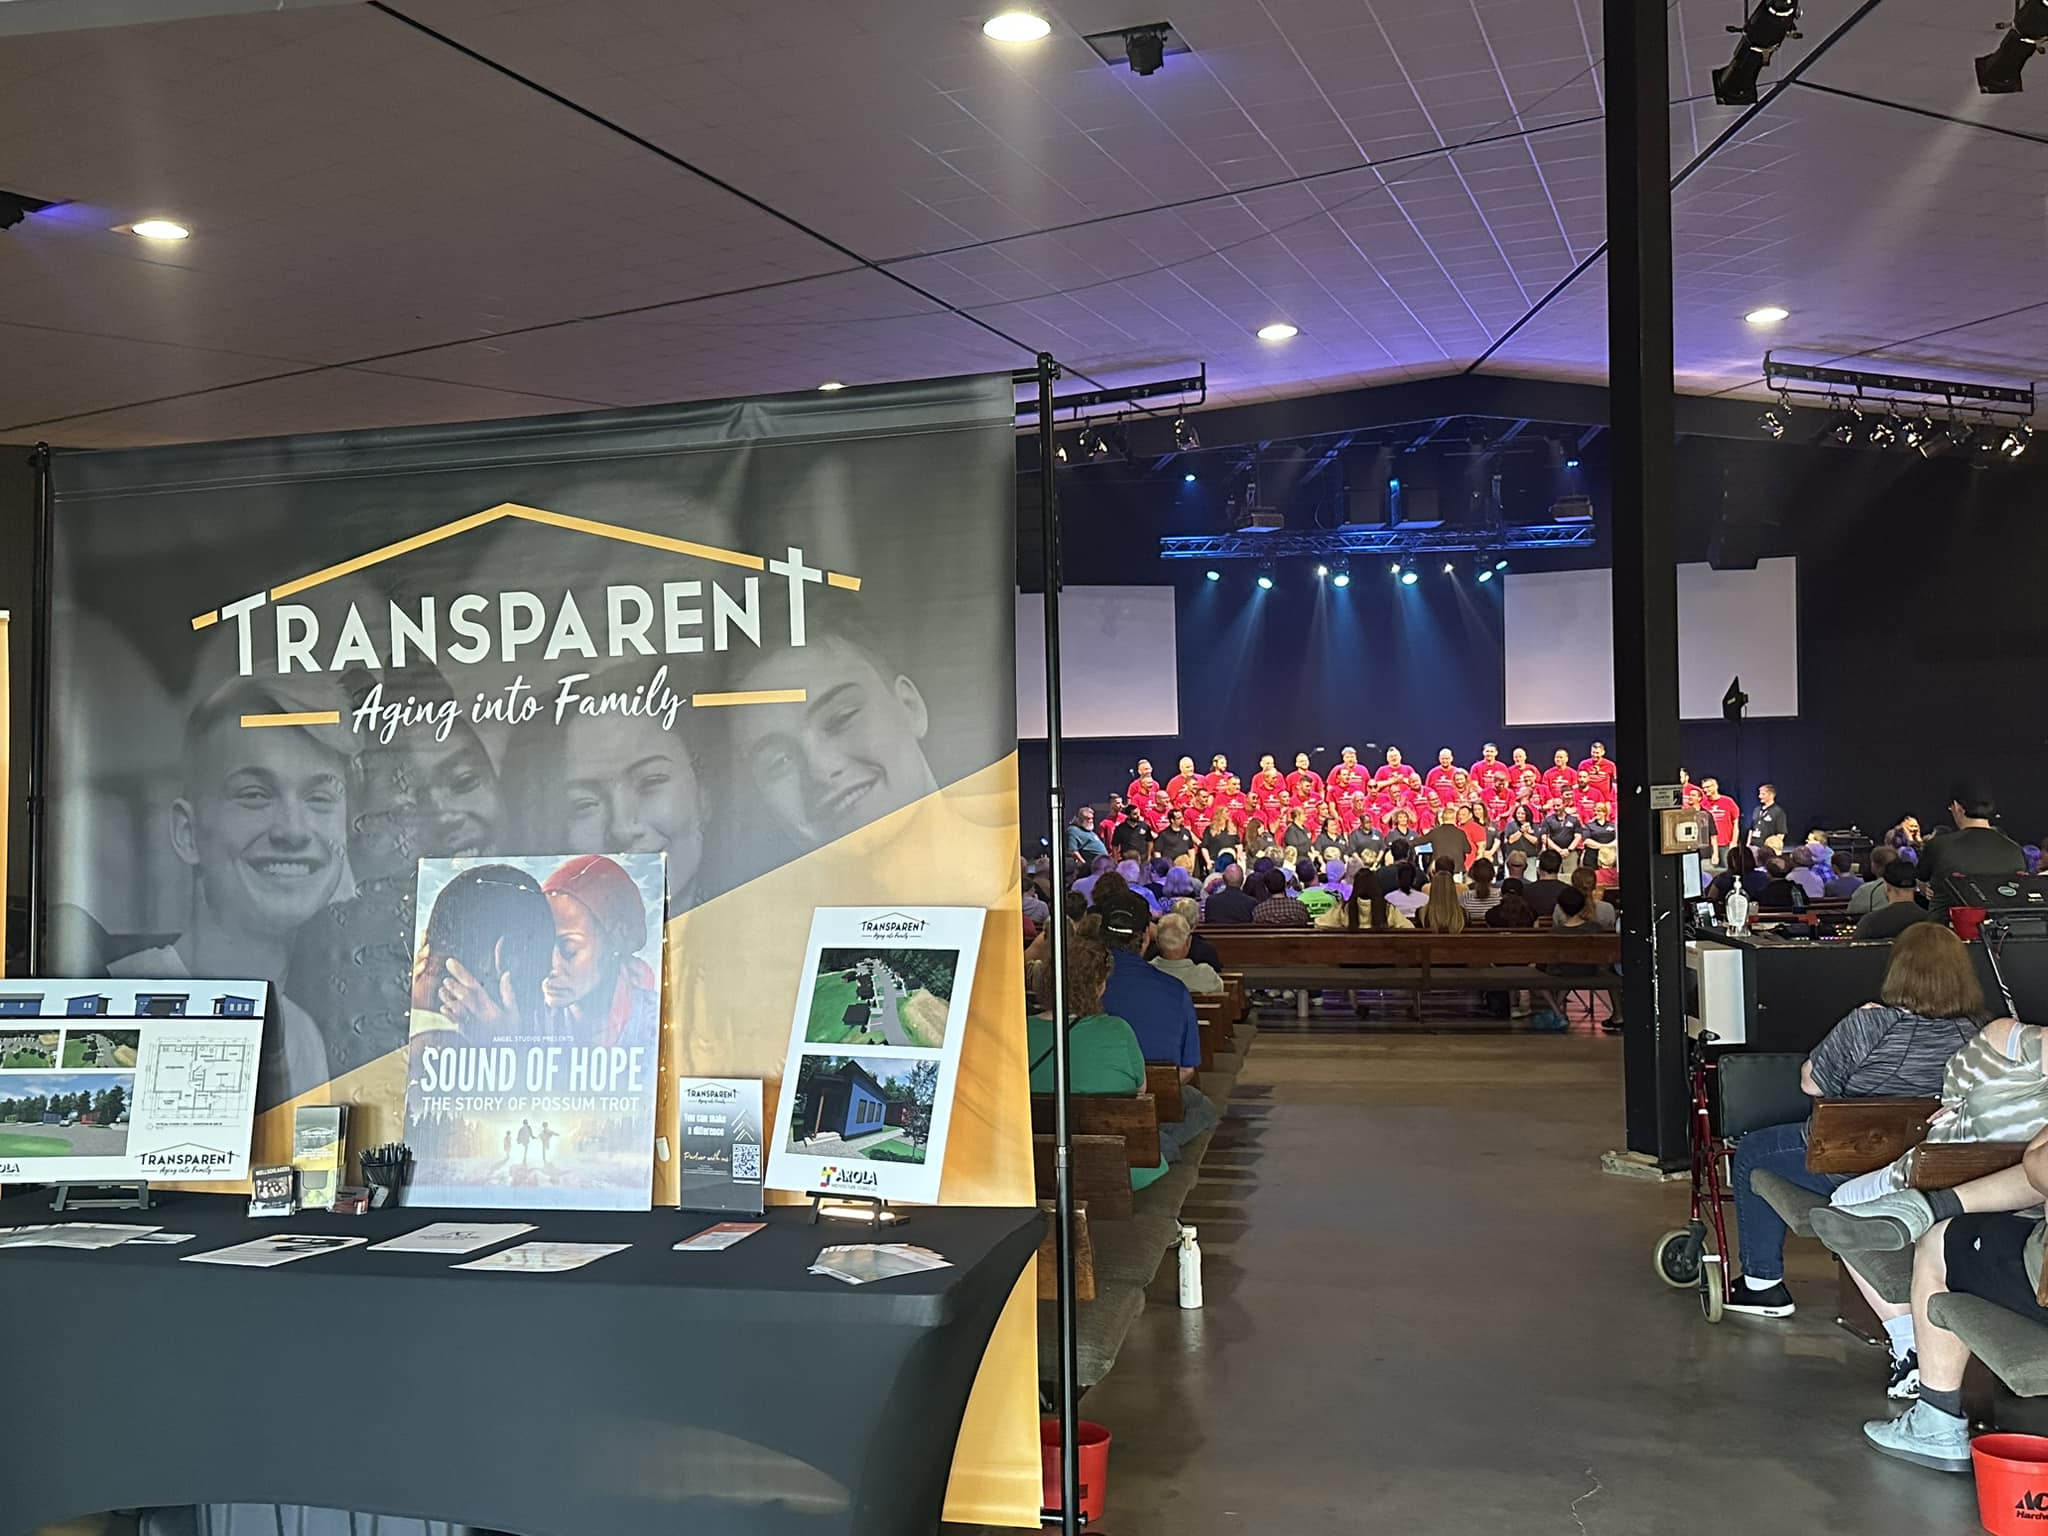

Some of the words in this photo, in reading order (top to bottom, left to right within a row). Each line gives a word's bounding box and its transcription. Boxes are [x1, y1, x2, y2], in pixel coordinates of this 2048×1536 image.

[222, 546, 822, 676] TRANSPARENT
[352, 682, 463, 745] Aging
[471, 674, 544, 725] into
[554, 664, 687, 731] Family
[862, 920, 925, 931] TRANSPARENT
[420, 1046, 517, 1092] SOUND
[526, 1046, 562, 1092] OF
[569, 1046, 645, 1092] HOPE
[687, 1088, 737, 1099] TRANSPARENT
[421, 1096, 451, 1112] THE
[455, 1096, 503, 1112] STORY
[507, 1096, 528, 1112] OF
[531, 1096, 595, 1112] POSSUM
[599, 1096, 640, 1112] TROT
[140, 1150, 234, 1166] TRANSPARENT
